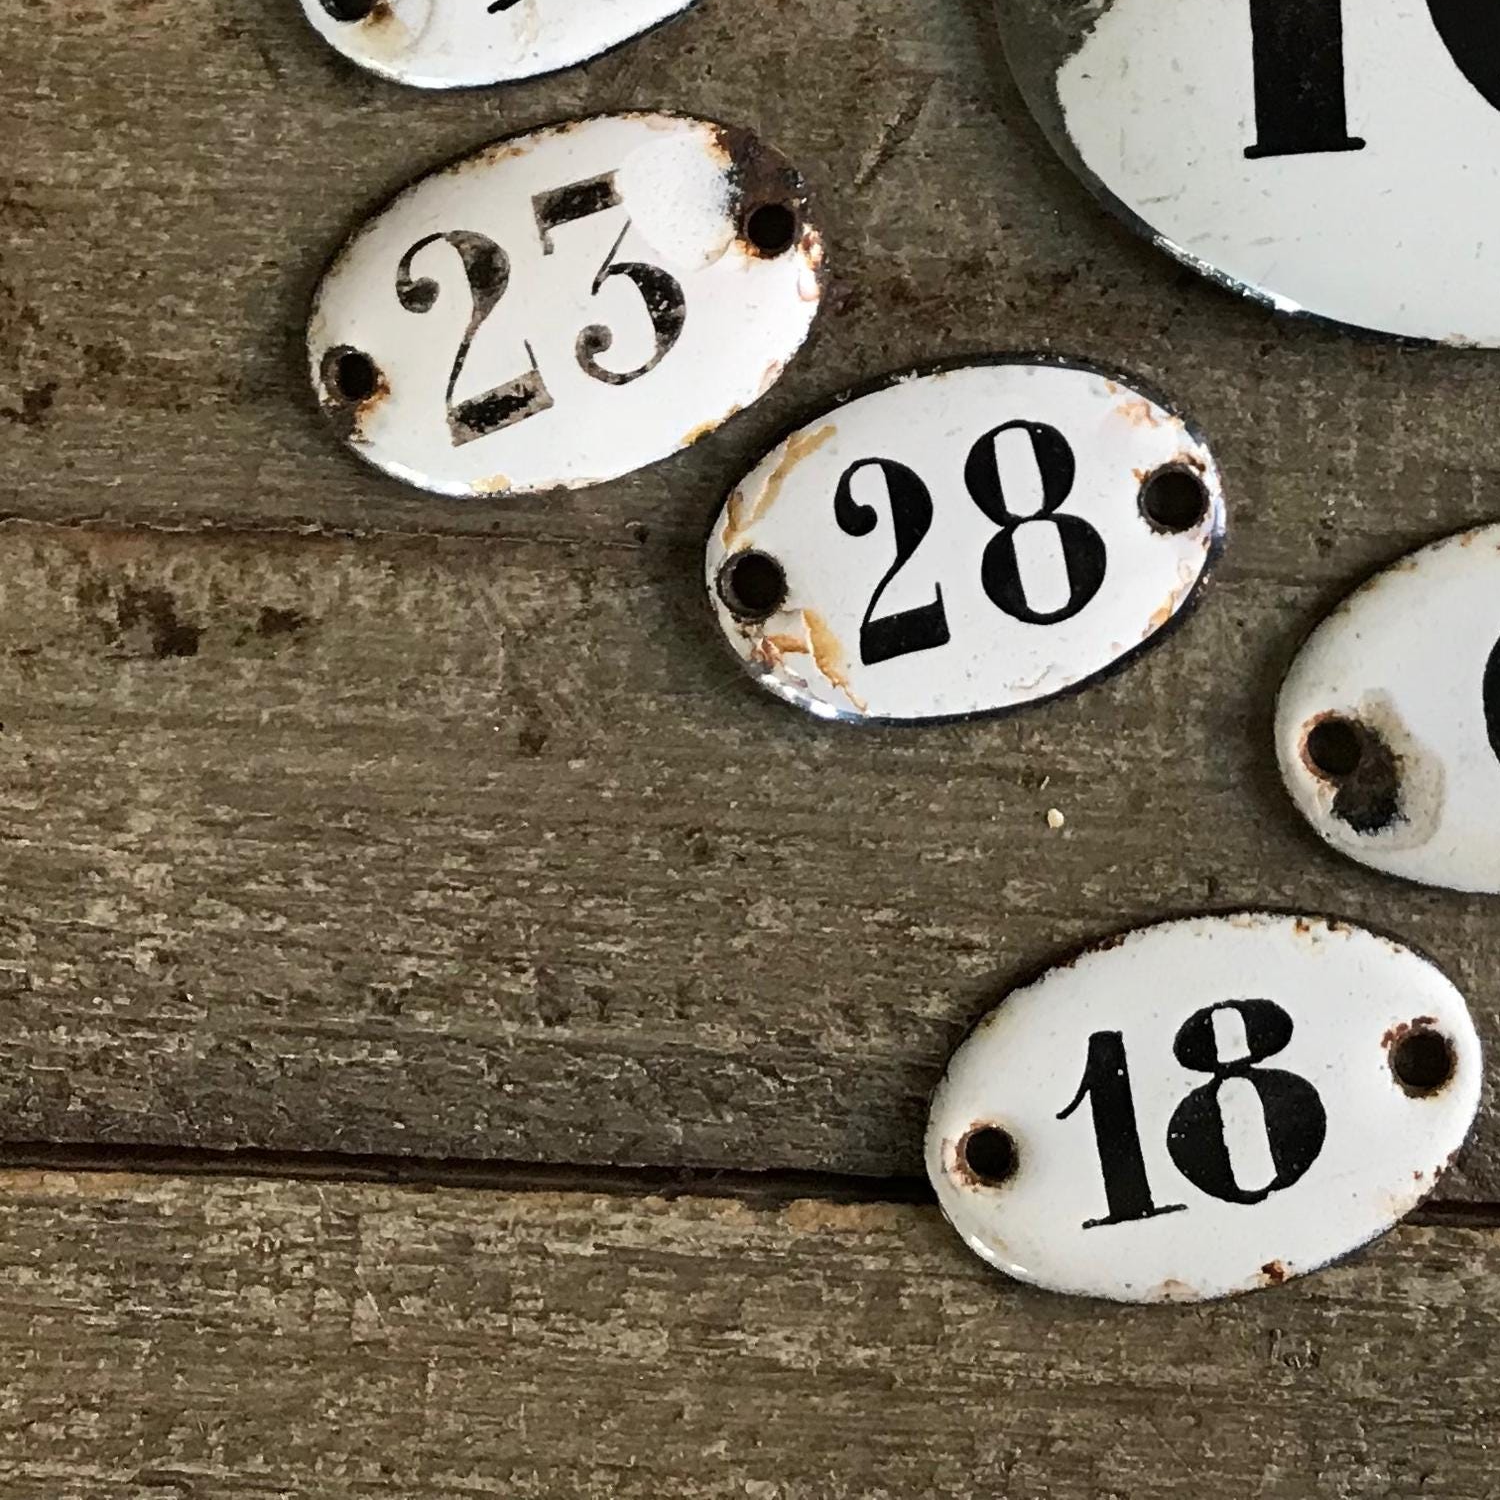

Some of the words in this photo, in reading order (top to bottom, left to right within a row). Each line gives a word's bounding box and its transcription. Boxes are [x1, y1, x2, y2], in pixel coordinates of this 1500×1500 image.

[394, 167, 687, 447] 23
[832, 418, 1108, 667] 28
[1054, 997, 1328, 1231] 18
